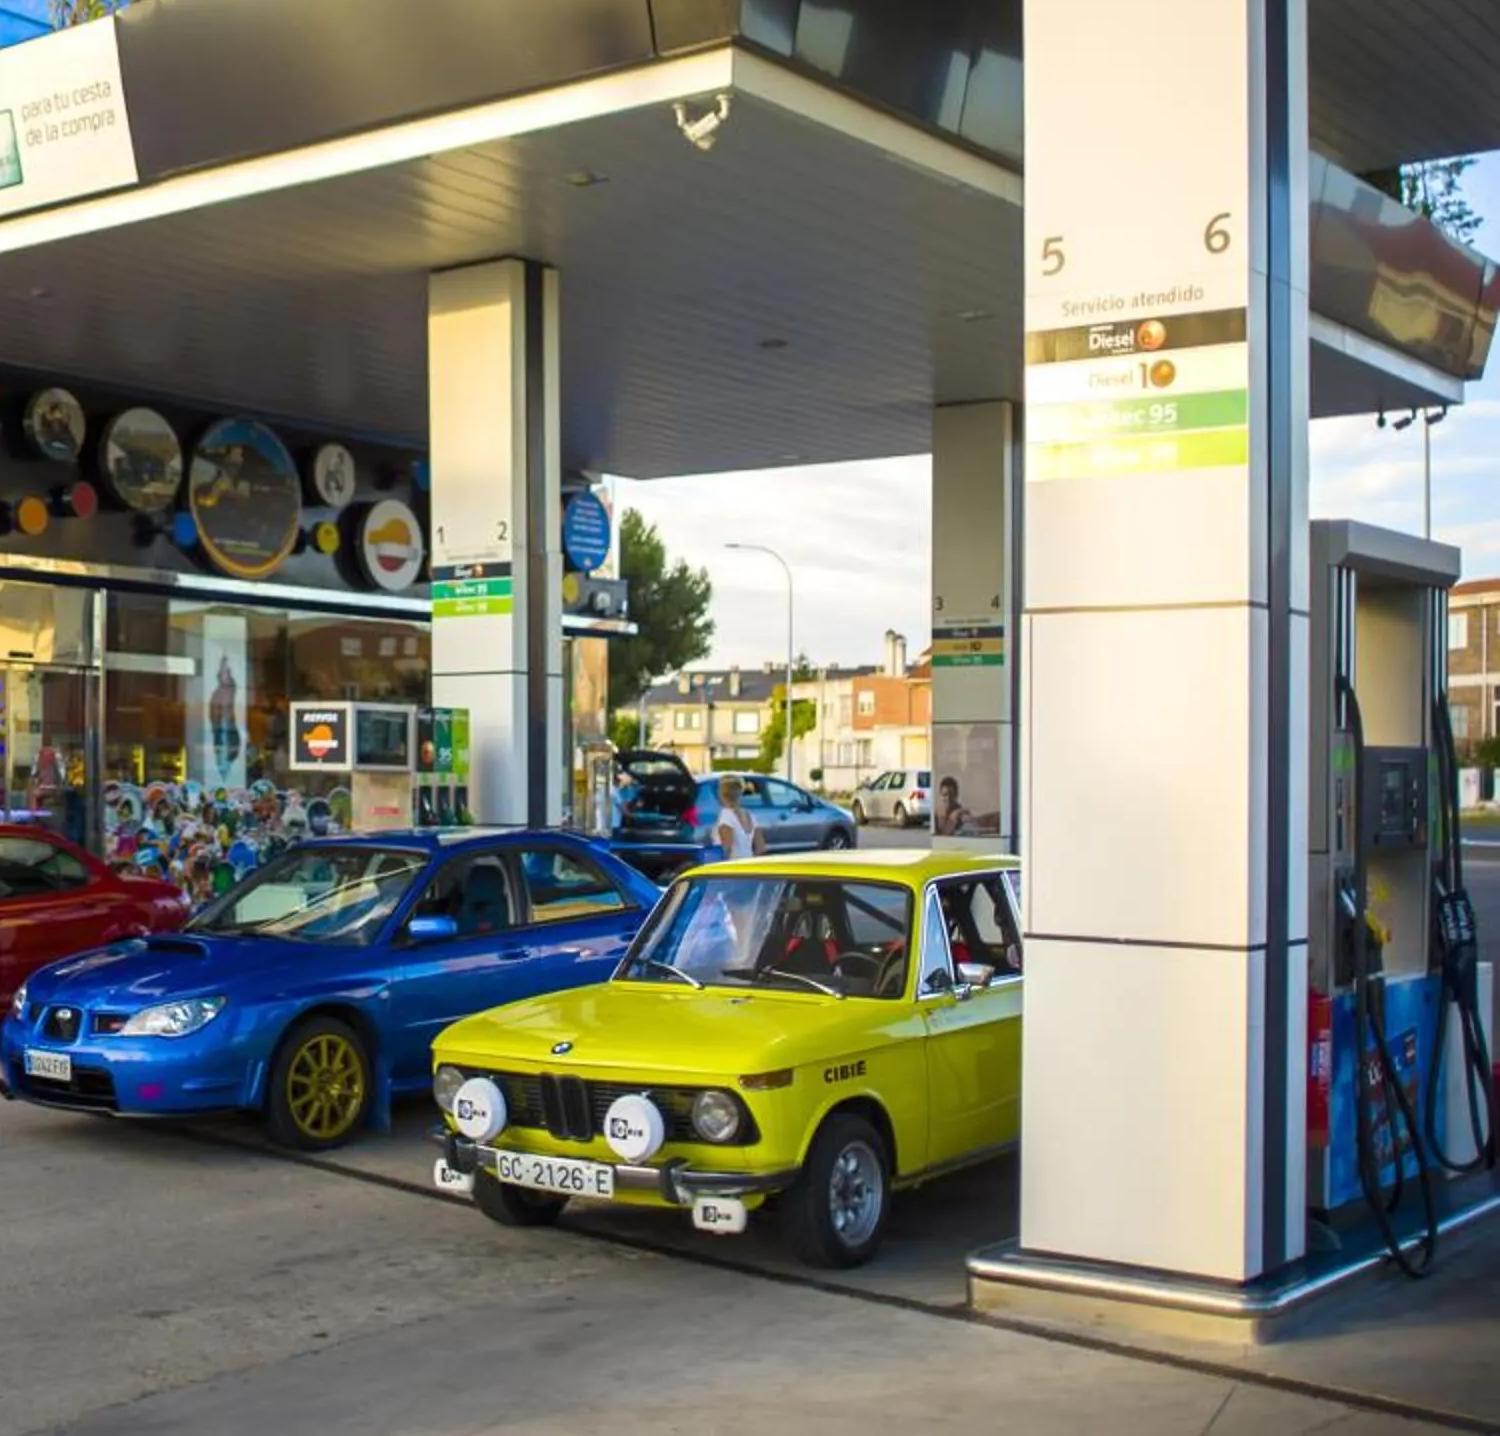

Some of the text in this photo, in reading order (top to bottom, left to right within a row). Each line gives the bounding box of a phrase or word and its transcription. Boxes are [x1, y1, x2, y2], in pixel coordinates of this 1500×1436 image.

[72, 79, 112, 107] cesta
[61, 109, 116, 138] compra
[1041, 211, 1231, 276] 5 6
[1061, 283, 1205, 318] Servicio atendido
[1089, 327, 1135, 352] Diesel
[1148, 402, 1178, 424] 95
[436, 519, 508, 545] 1 2
[934, 594, 1000, 611] 3 4
